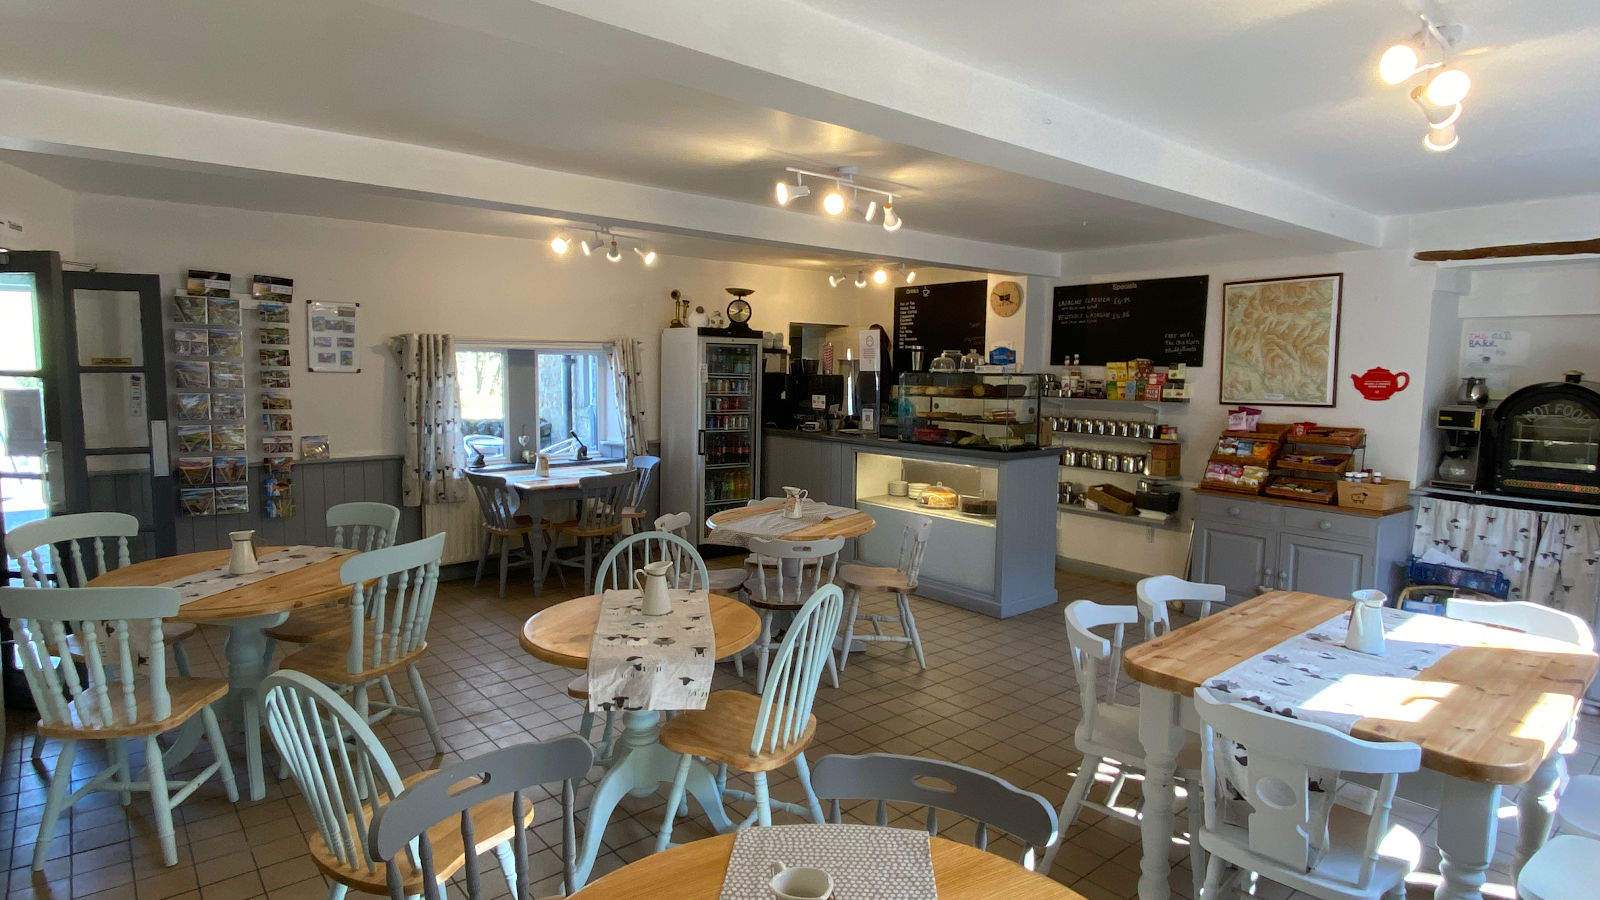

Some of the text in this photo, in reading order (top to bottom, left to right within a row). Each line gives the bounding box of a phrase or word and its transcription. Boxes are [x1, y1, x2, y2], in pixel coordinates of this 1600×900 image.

[1113, 282, 1138, 291] Specials
[1058, 299, 1083, 307] LASAGNE
[1492, 331, 1512, 340] OLD
[1522, 403, 1591, 424] HOT FOOD
